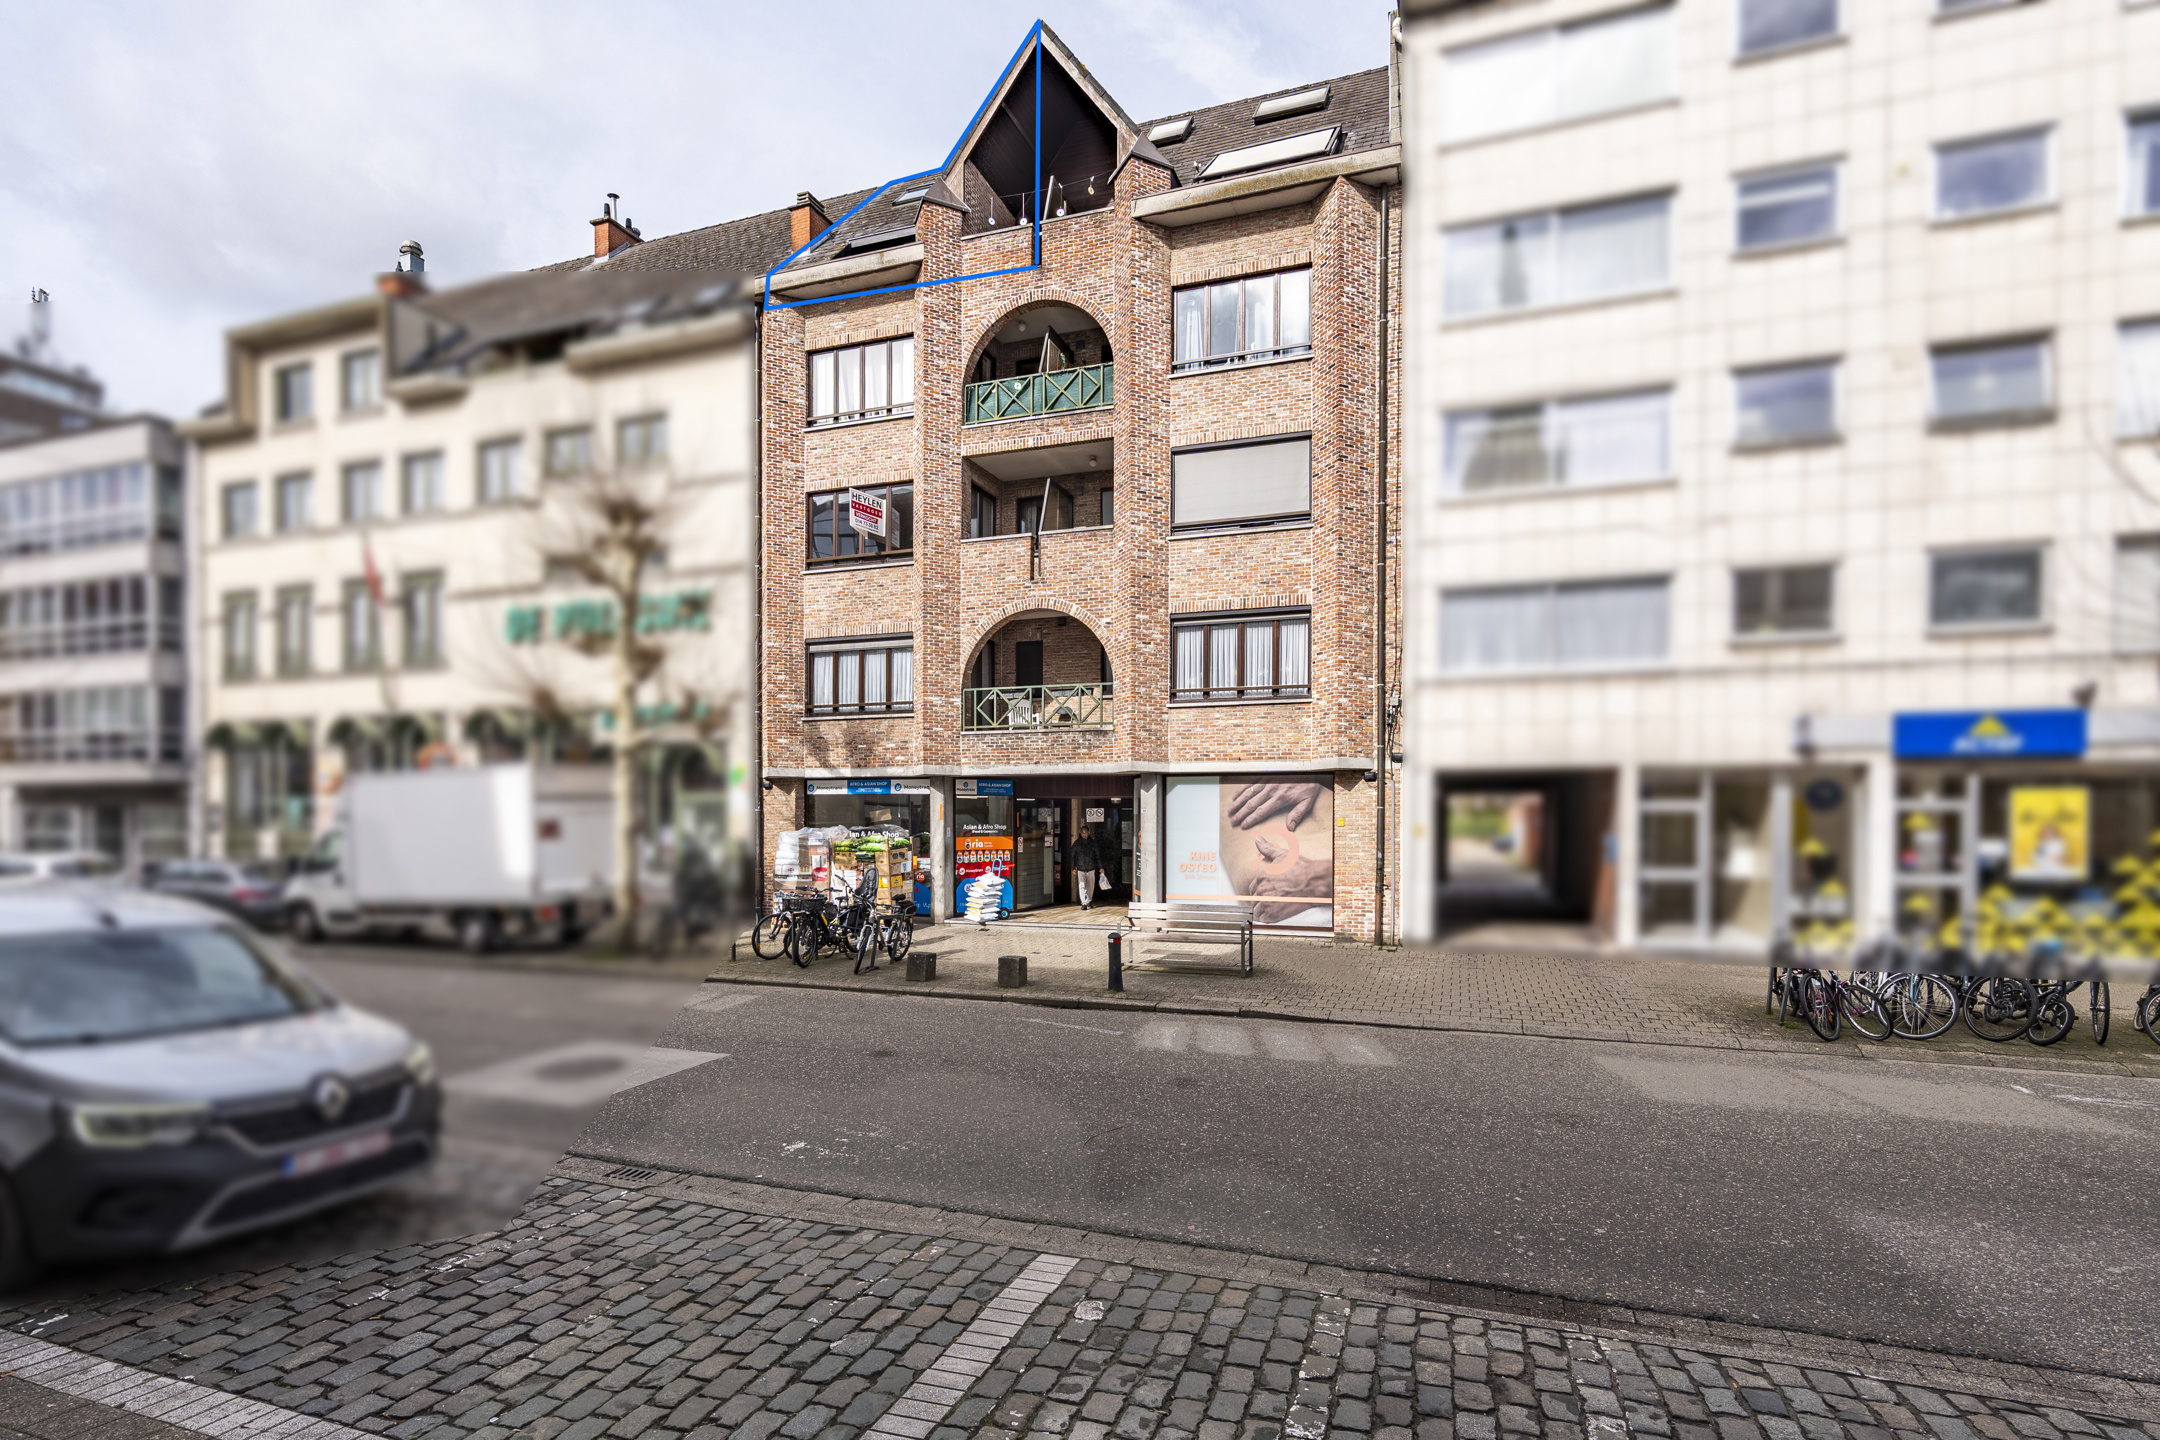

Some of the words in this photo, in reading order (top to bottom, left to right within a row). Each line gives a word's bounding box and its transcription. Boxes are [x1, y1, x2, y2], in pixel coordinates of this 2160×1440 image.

[852, 492, 882, 510] HEYLEN
[972, 839, 983, 848] ria
[1189, 851, 1216, 861] KINE
[1178, 862, 1216, 872] OSTEO
